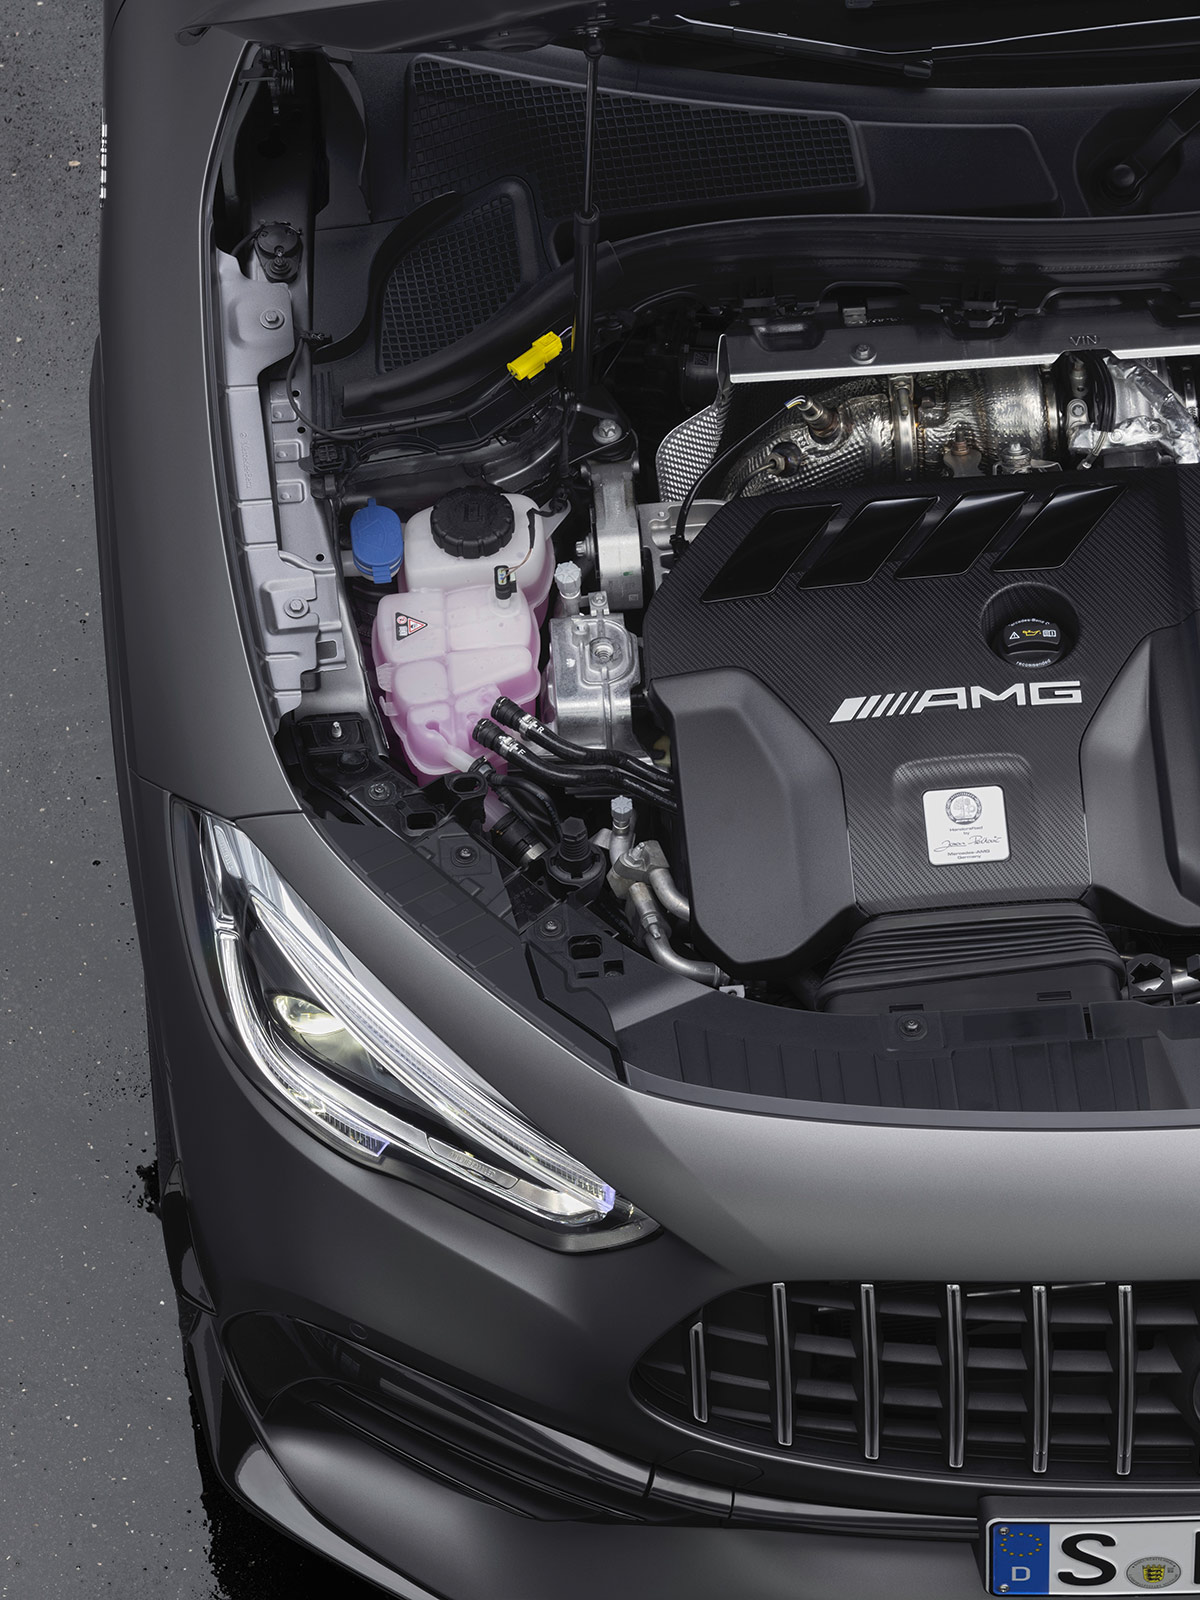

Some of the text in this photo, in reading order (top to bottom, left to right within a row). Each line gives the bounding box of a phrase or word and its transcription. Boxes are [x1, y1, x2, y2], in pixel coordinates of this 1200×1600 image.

[1069, 334, 1097, 346] VIN
[910, 680, 1083, 715] AMG
[1057, 1533, 1118, 1587] S
[1011, 1566, 1031, 1582] D
